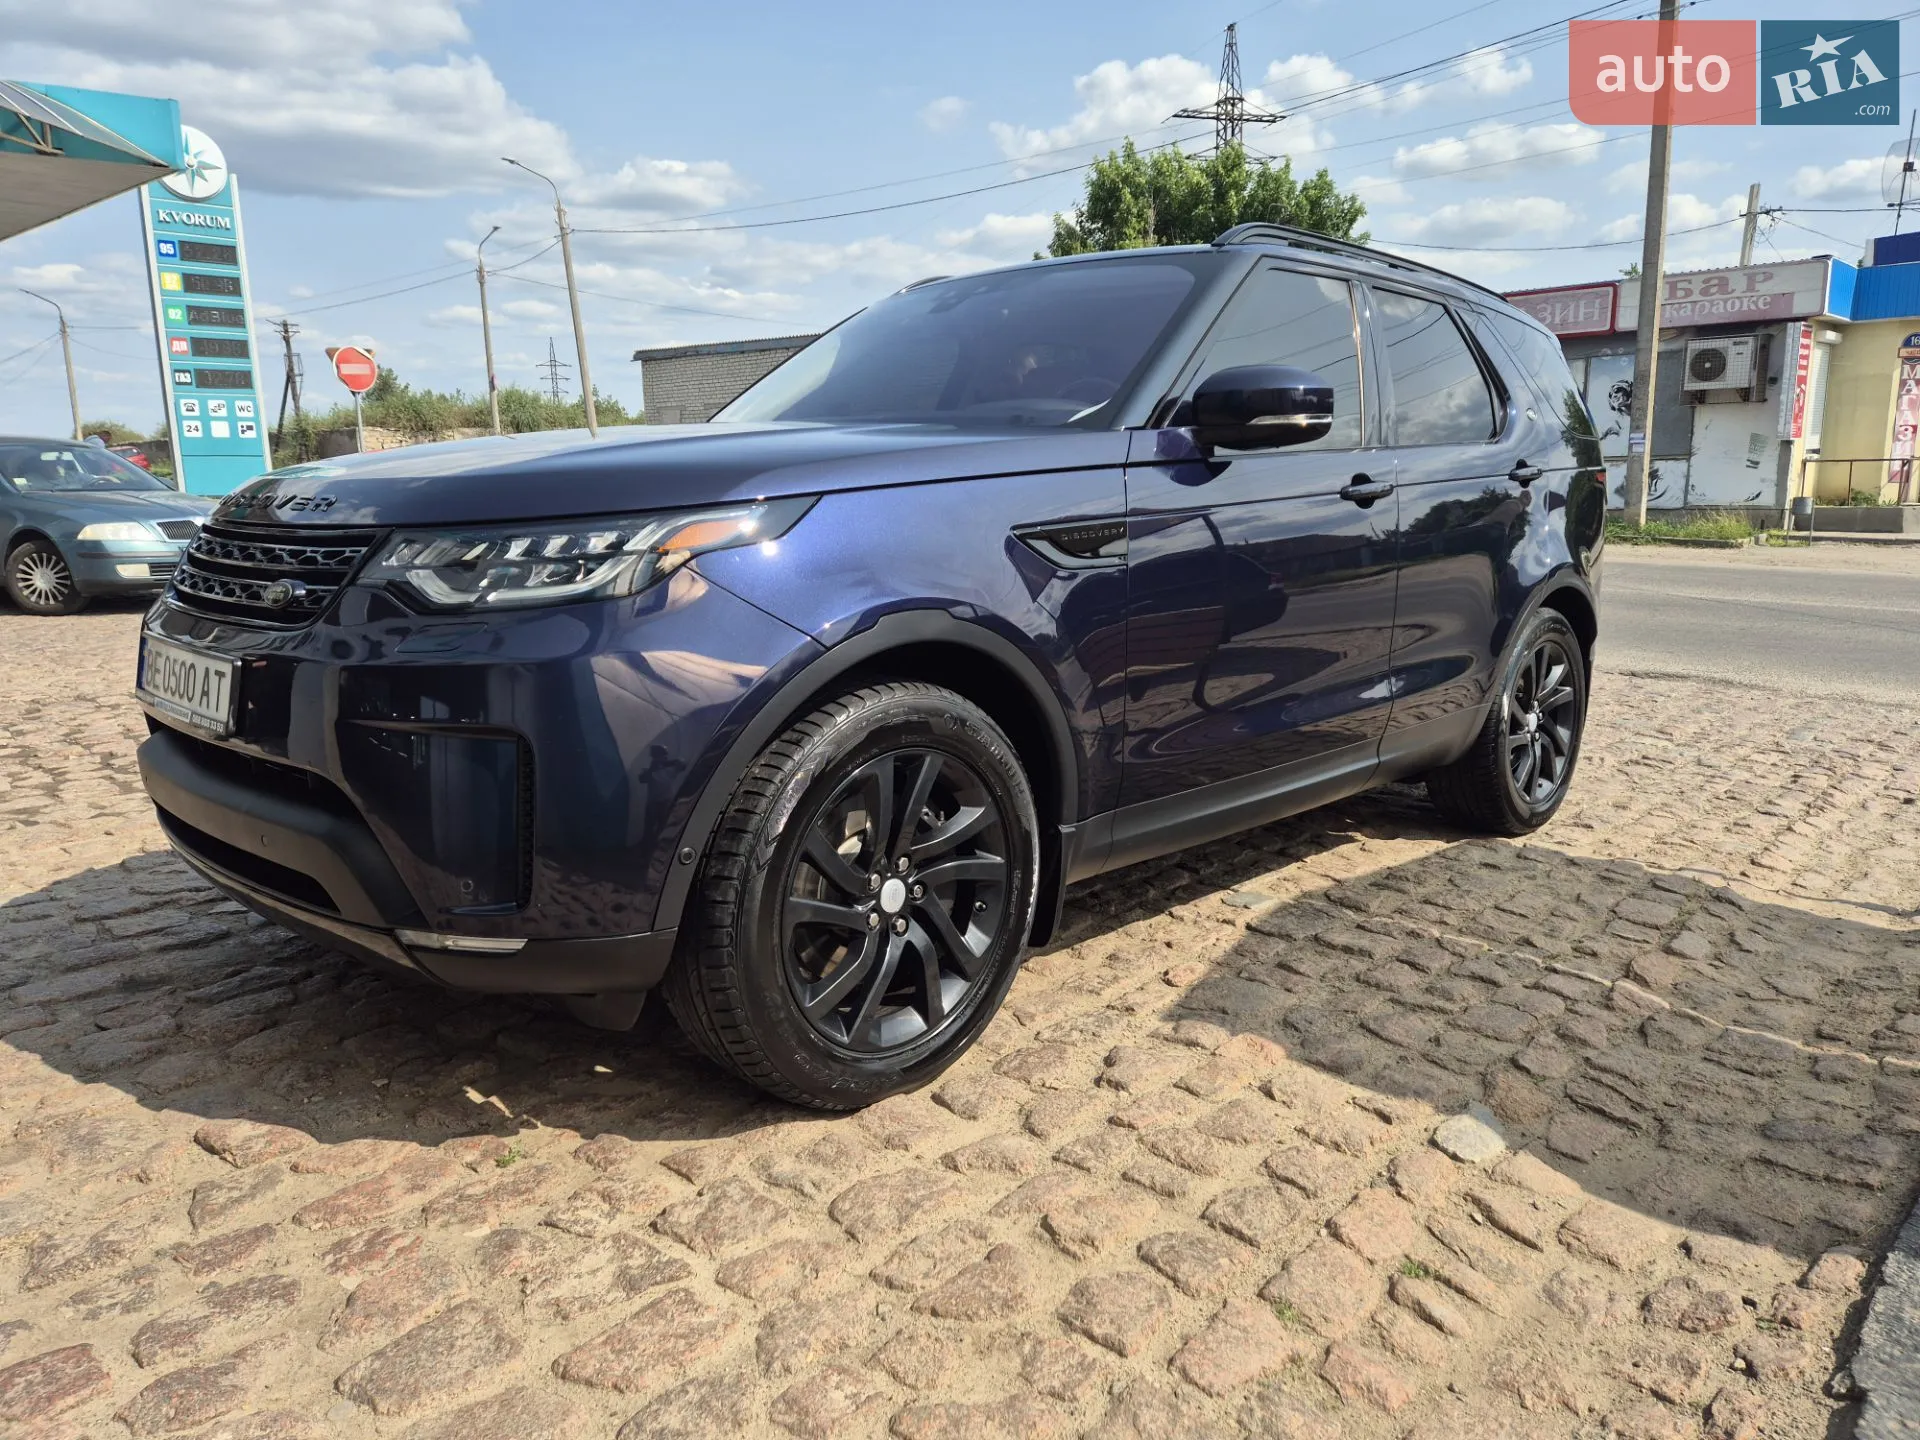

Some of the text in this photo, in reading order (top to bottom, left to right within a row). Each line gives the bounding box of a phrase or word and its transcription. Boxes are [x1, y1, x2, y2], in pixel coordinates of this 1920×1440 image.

[157, 209, 232, 230] KVORUM
[159, 243, 175, 255] 95
[167, 308, 183, 320] 92
[1521, 299, 1602, 326] ЗИН
[1663, 295, 1772, 321] караоке
[174, 372, 192, 384] ГАЗ
[237, 405, 252, 413] WC
[186, 425, 200, 433] 24
[1061, 526, 1124, 541] DISCOVERY
[163, 655, 197, 703] 0500
[199, 666, 226, 712] AT
